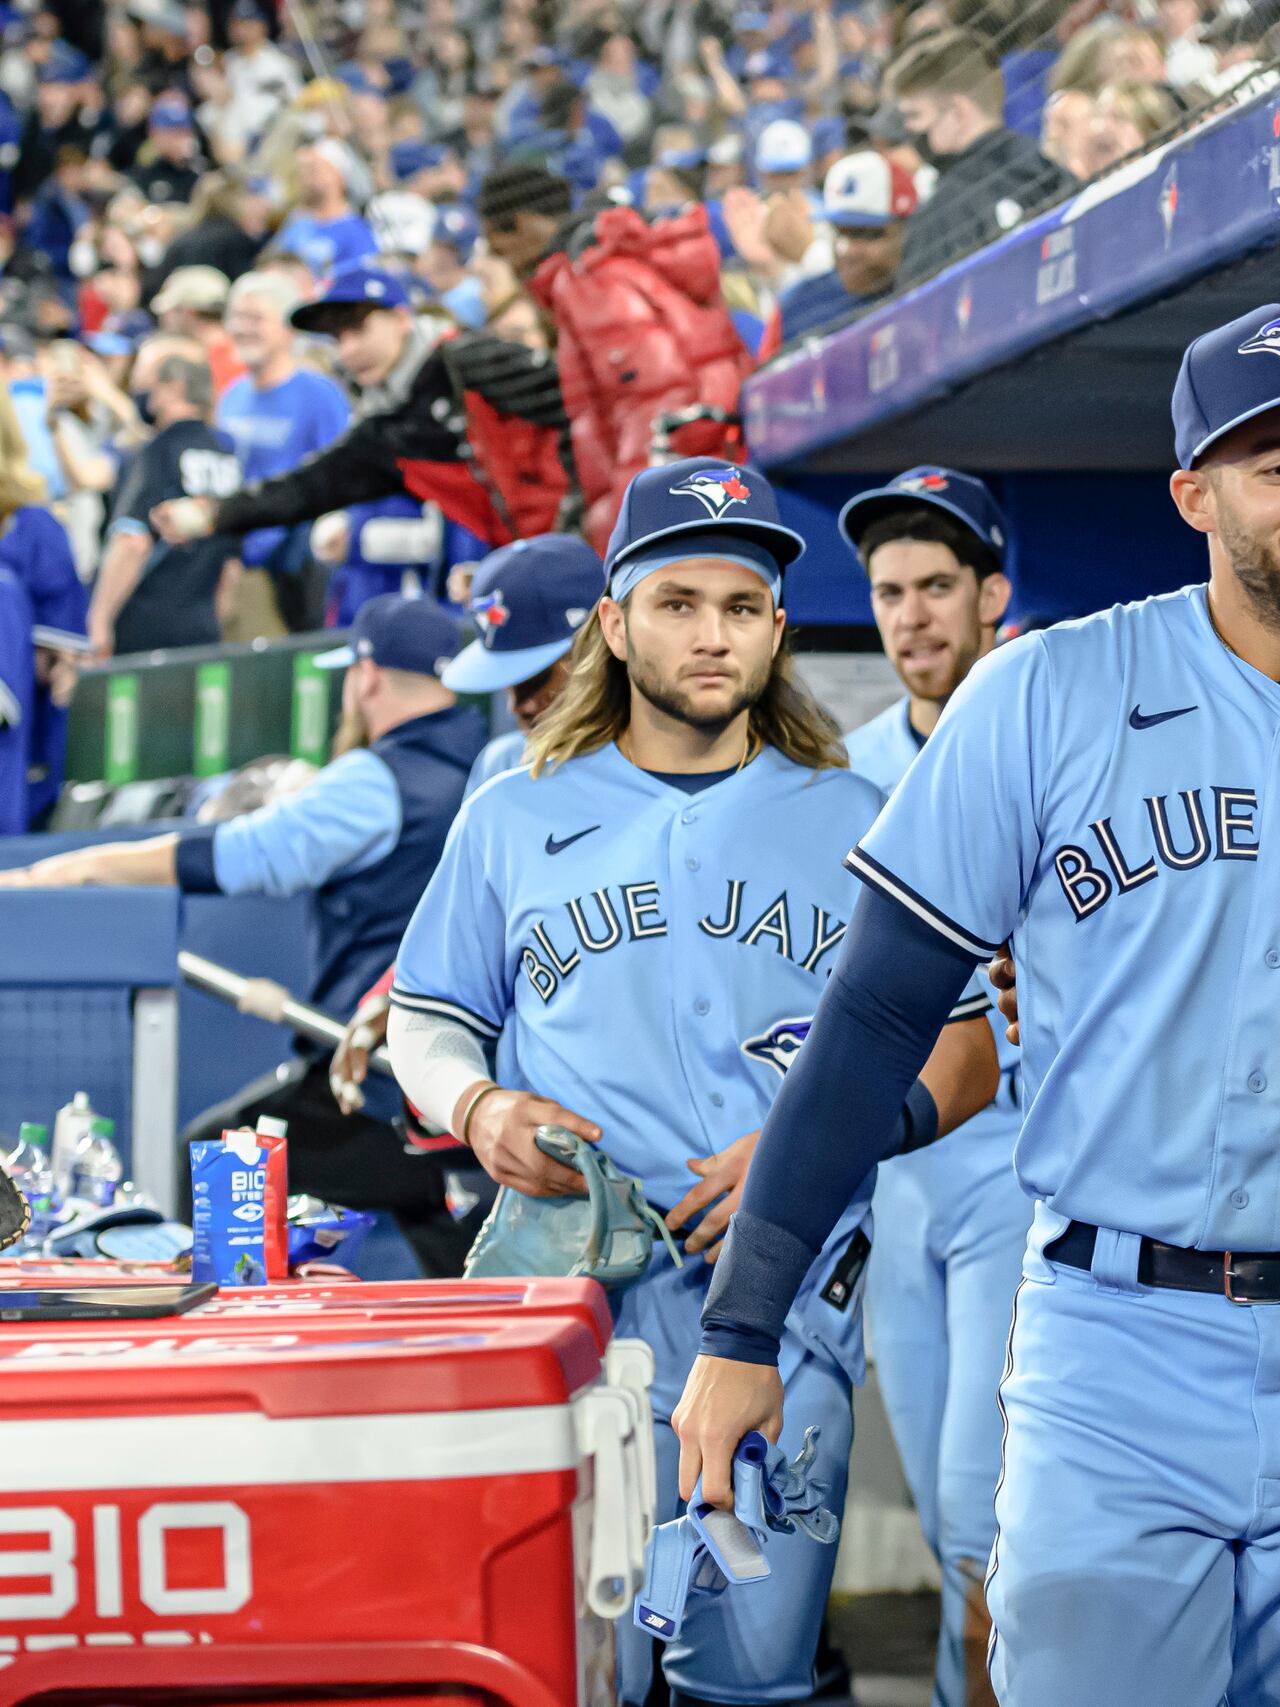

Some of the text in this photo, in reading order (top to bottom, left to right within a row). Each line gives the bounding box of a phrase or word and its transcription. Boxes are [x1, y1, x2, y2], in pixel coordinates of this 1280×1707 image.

[1054, 785, 1259, 924] BLUE
[522, 879, 849, 1005] BLUE JAY
[231, 1170, 266, 1192] BIO
[0, 1501, 253, 1622] BIO
